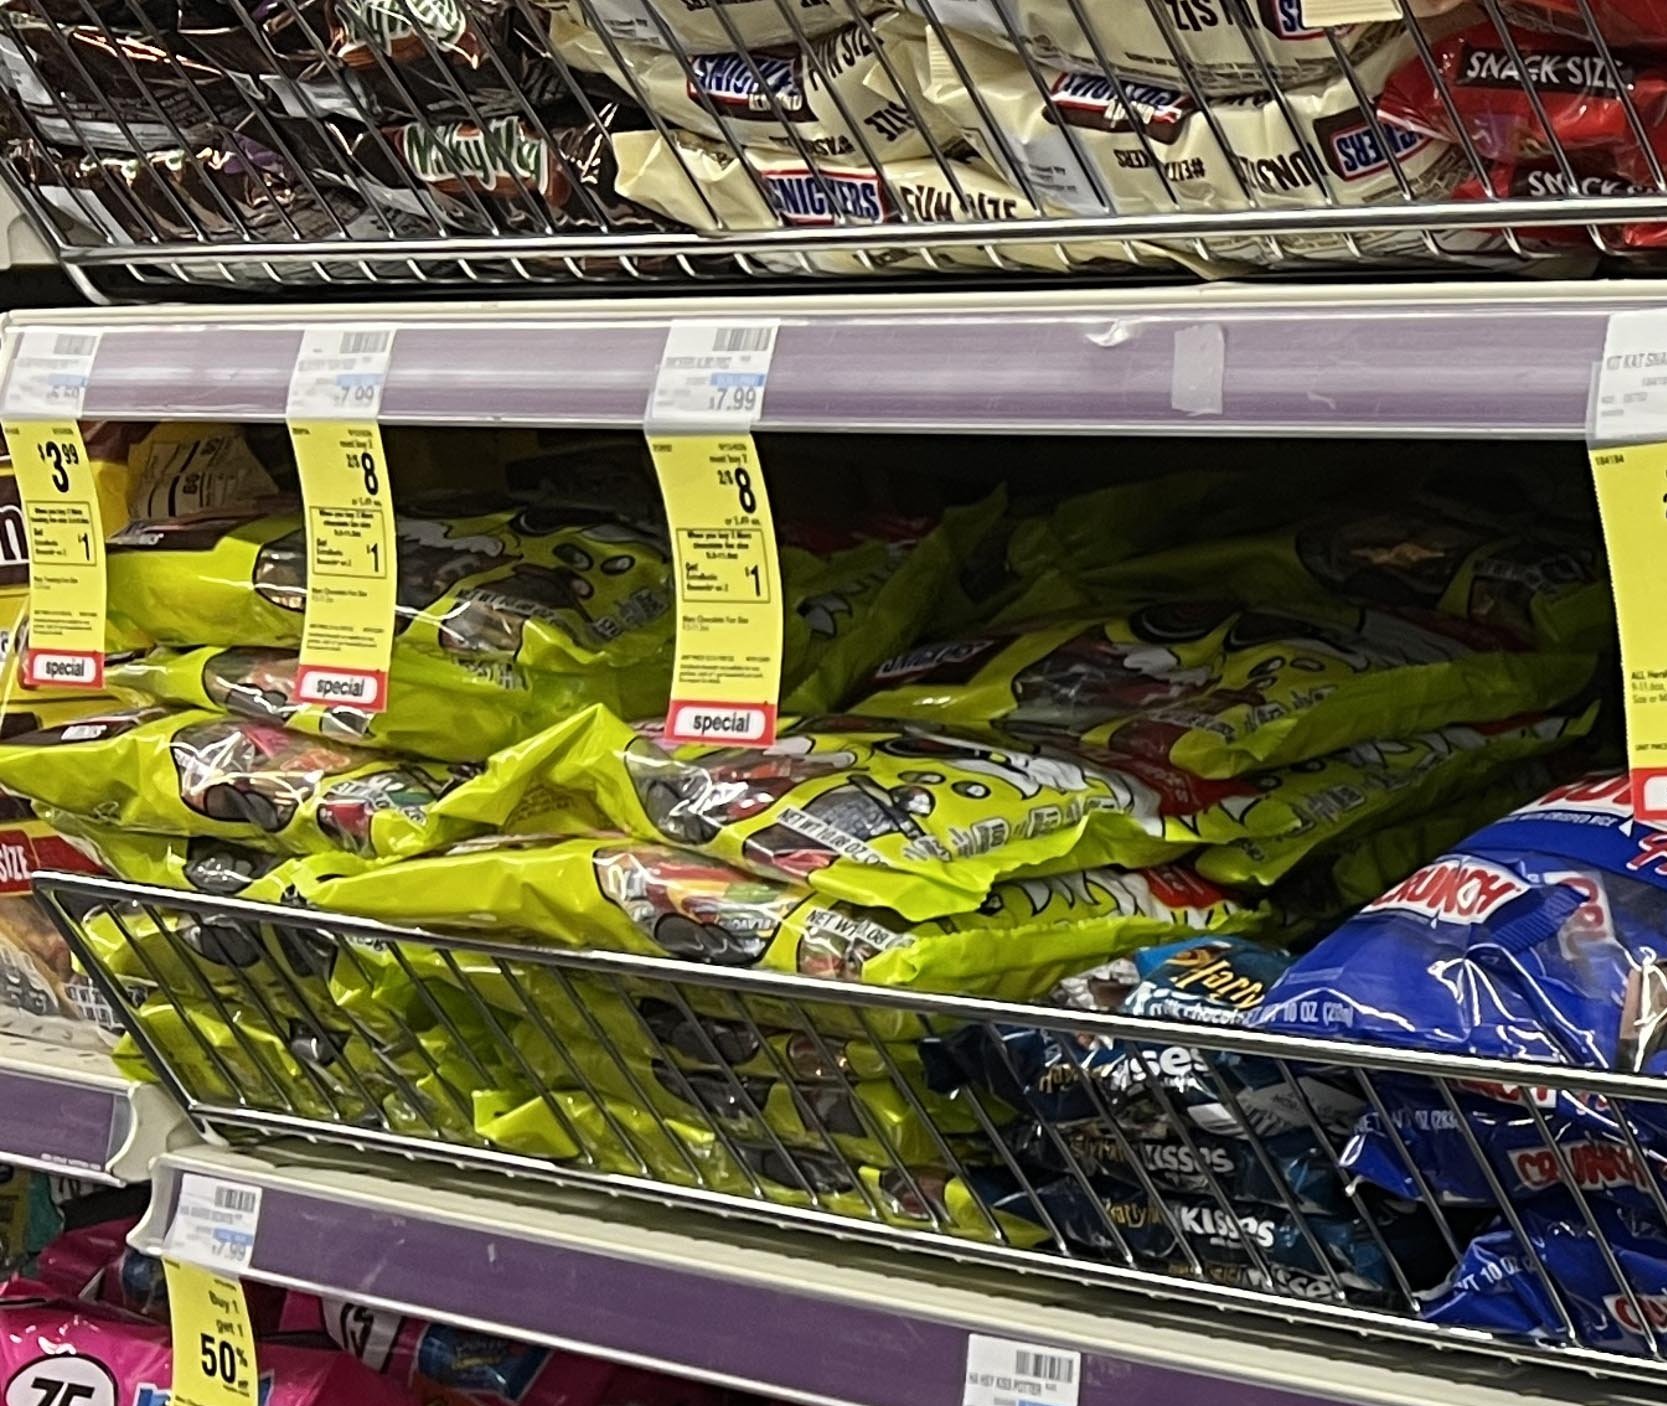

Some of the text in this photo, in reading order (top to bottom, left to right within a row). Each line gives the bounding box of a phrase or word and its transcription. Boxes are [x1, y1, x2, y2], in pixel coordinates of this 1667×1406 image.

[44, 657, 85, 679] special
[316, 677, 365, 700] special
[692, 711, 751, 736] special
